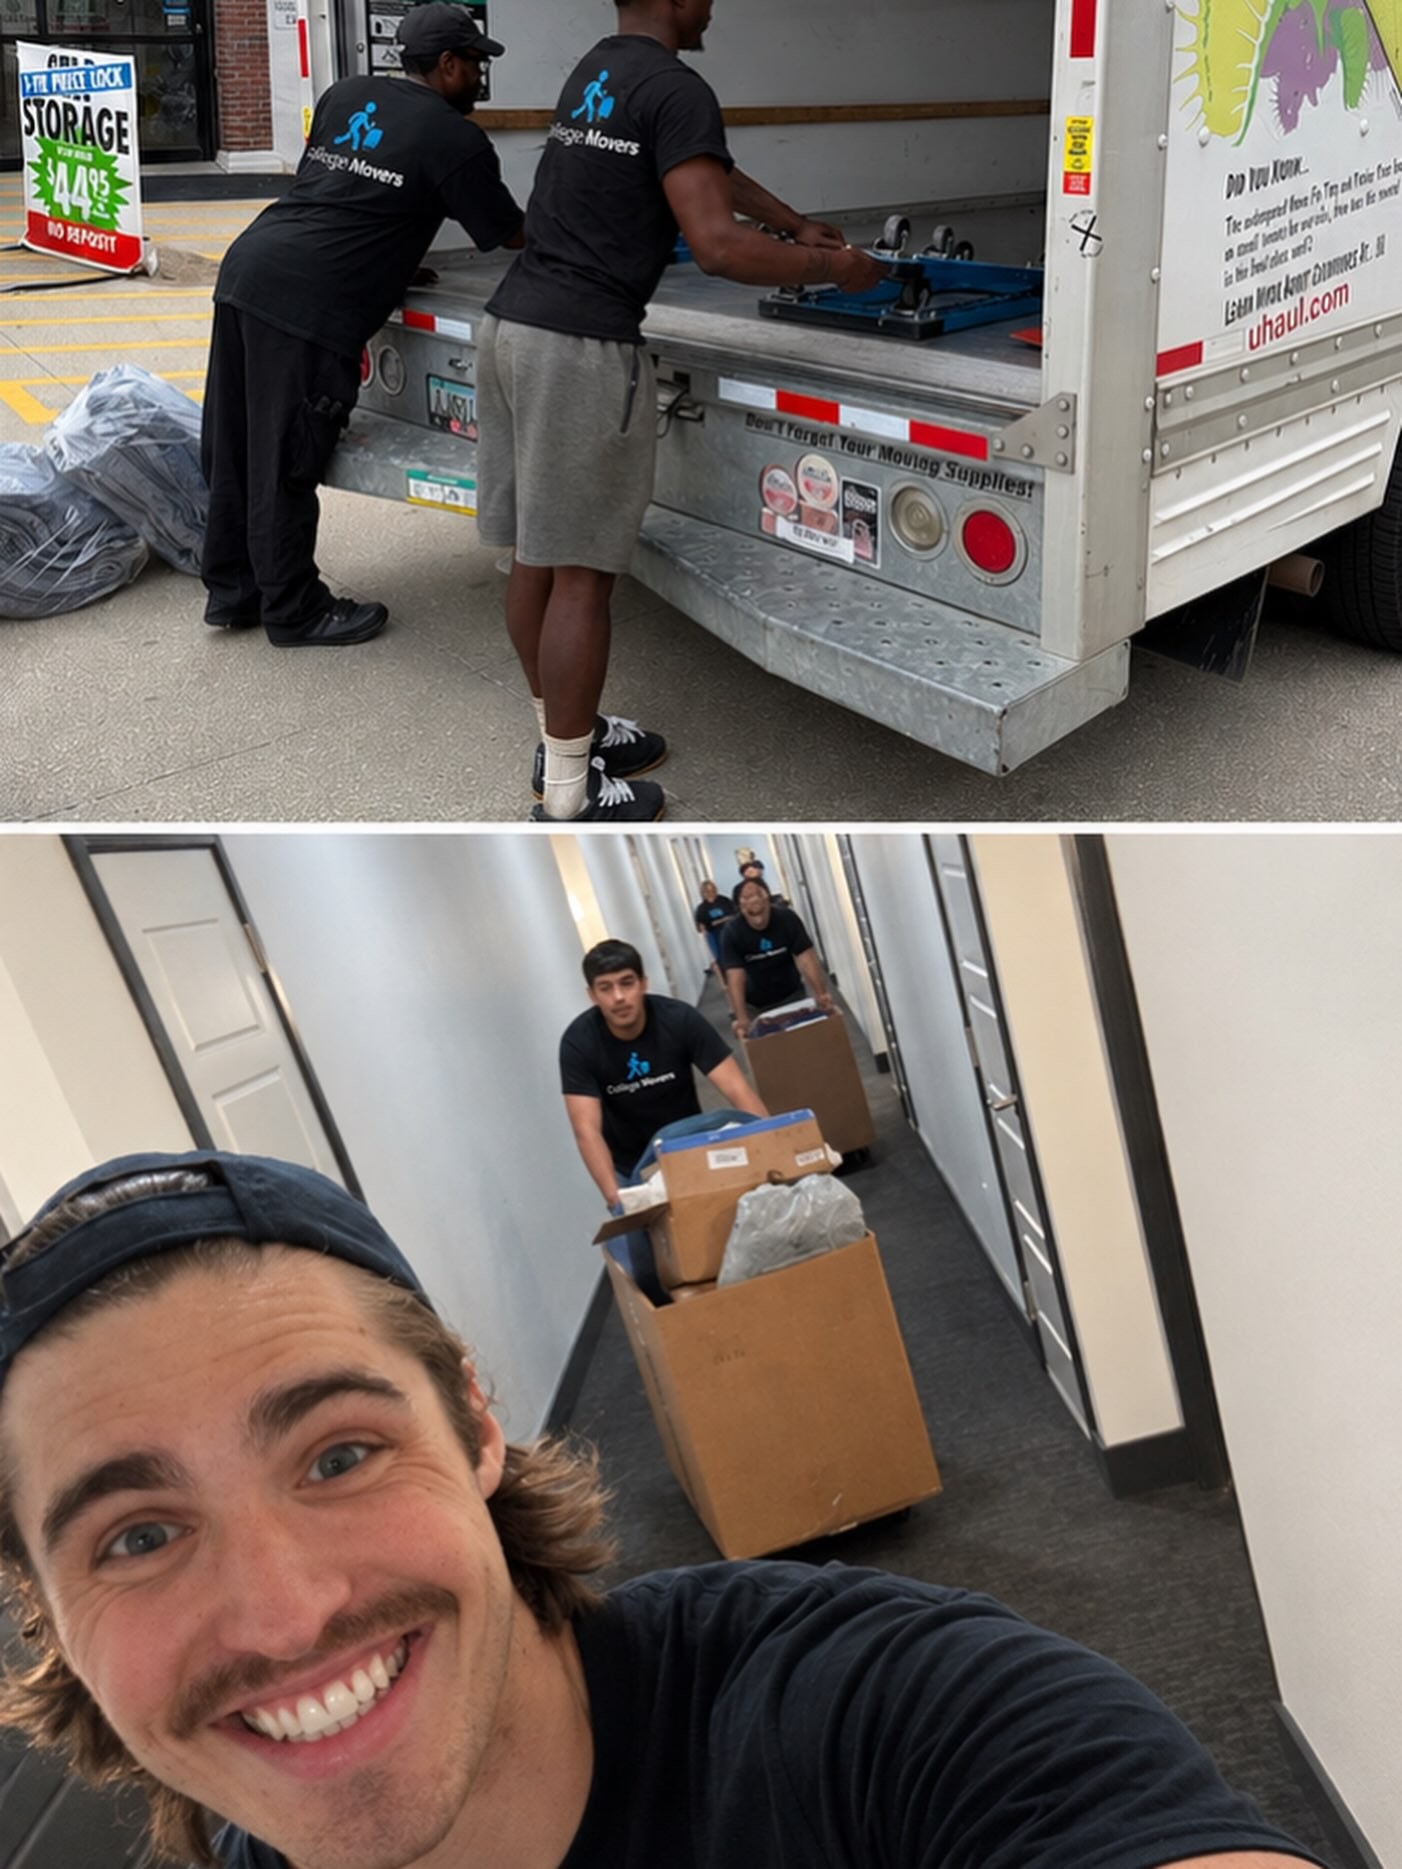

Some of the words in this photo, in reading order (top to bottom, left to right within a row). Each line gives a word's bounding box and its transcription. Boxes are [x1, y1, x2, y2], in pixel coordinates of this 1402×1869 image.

[23, 97, 130, 155] STORAGE
[585, 128, 640, 156] Movers
[348, 157, 404, 188] Movers
[1249, 283, 1350, 351] uhaul.com
[839, 434, 876, 457] Your
